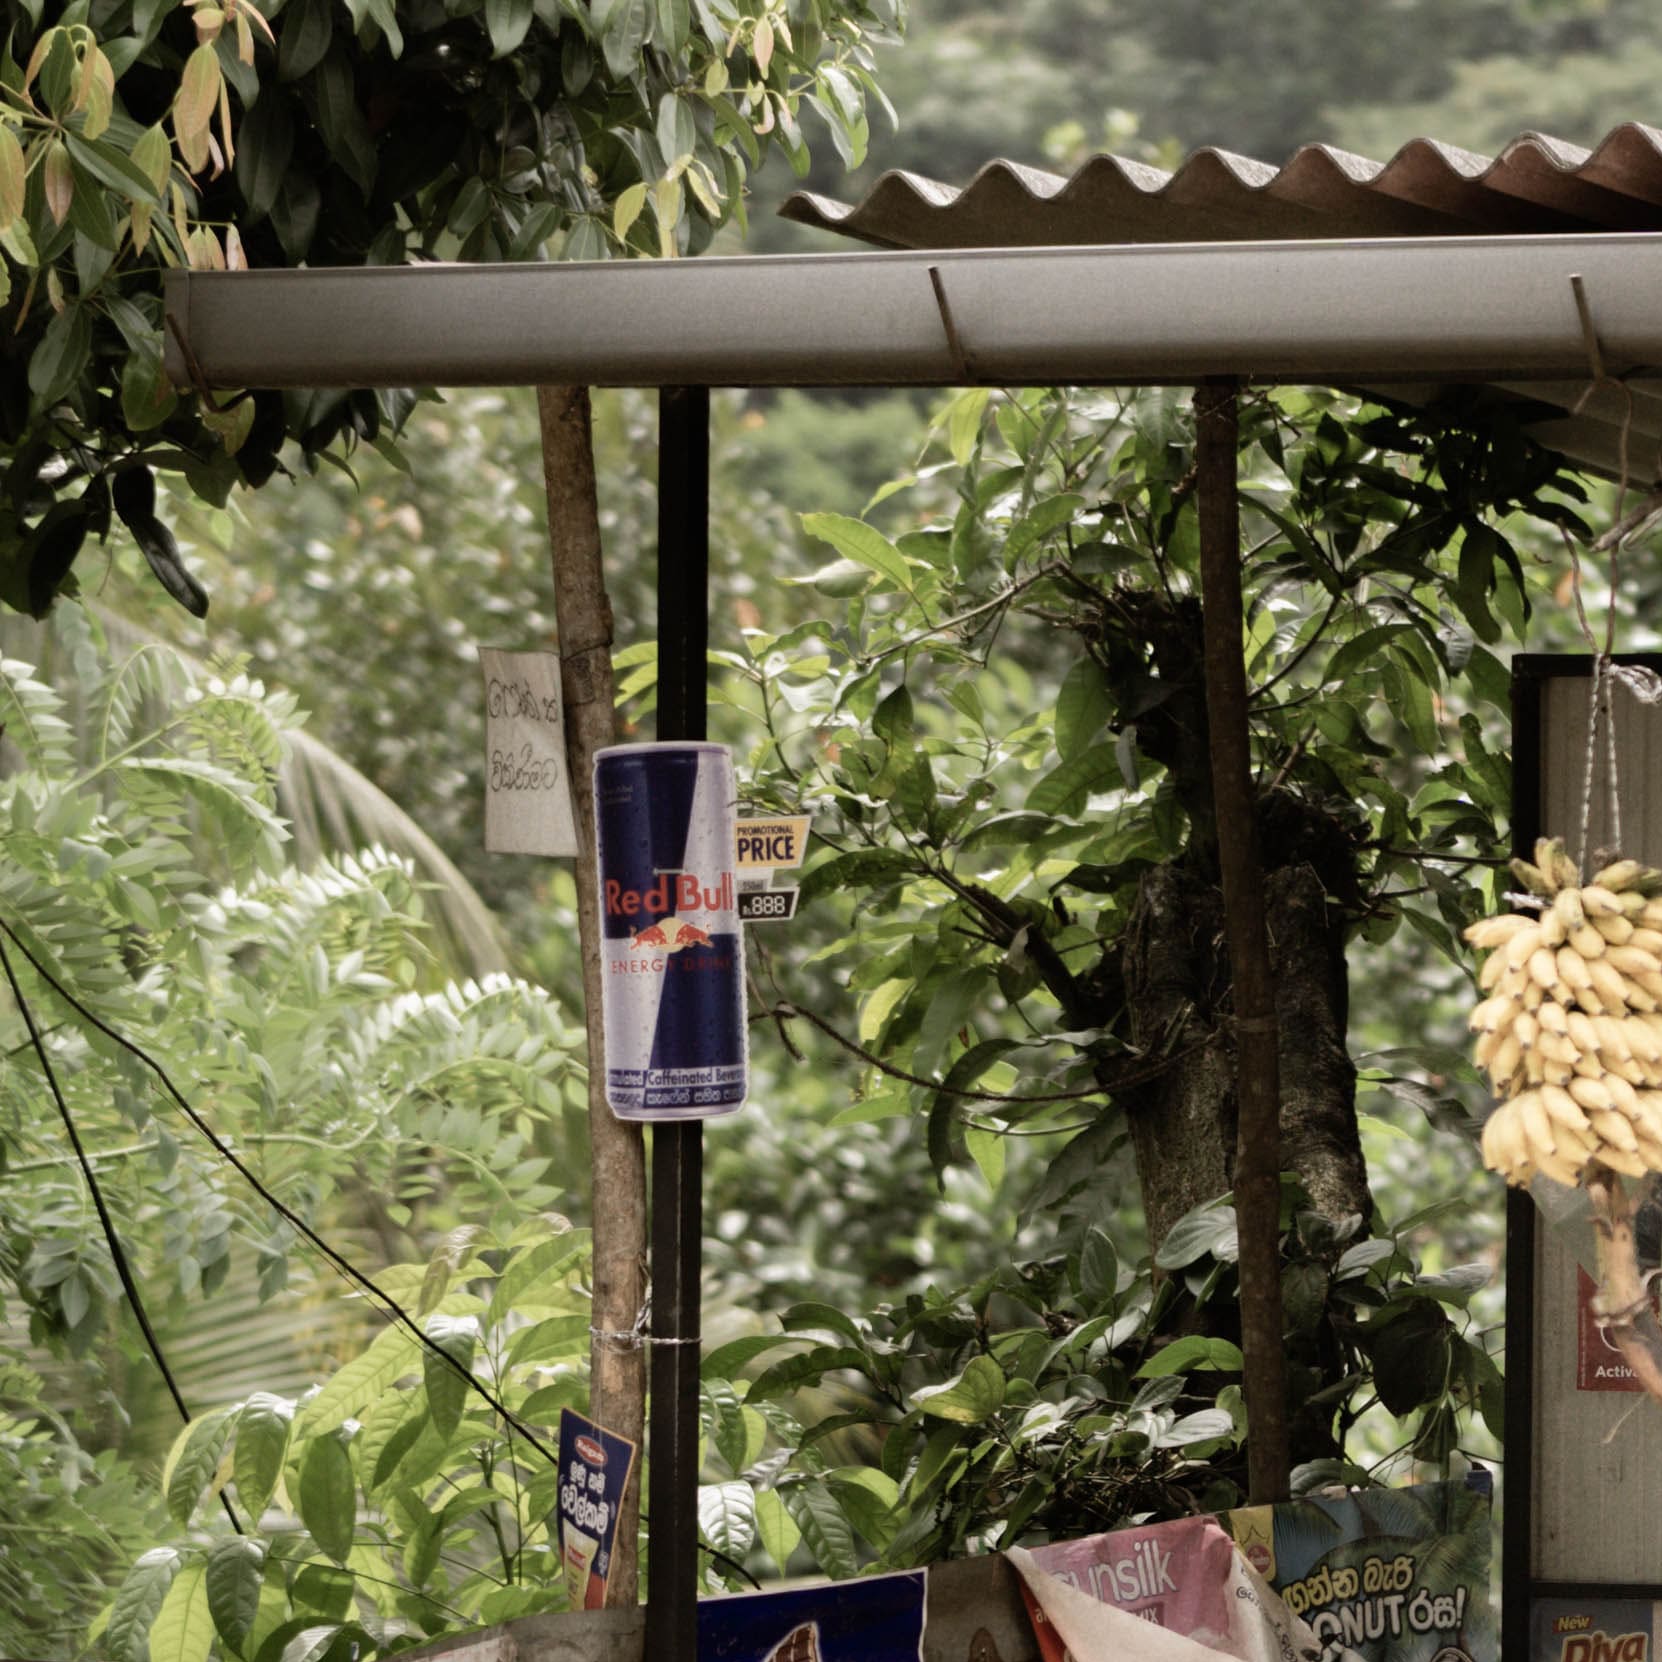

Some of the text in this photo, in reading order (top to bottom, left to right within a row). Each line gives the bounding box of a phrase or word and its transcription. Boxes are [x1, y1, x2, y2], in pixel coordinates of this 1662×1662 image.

[737, 825, 794, 836] PROMOTIONAL
[738, 836, 795, 862] PRICE
[605, 872, 734, 915] Red Bull
[649, 1069, 712, 1086] Caffeinated
[1310, 1594, 1407, 1650] ONUT
[1558, 1615, 1589, 1631] New
